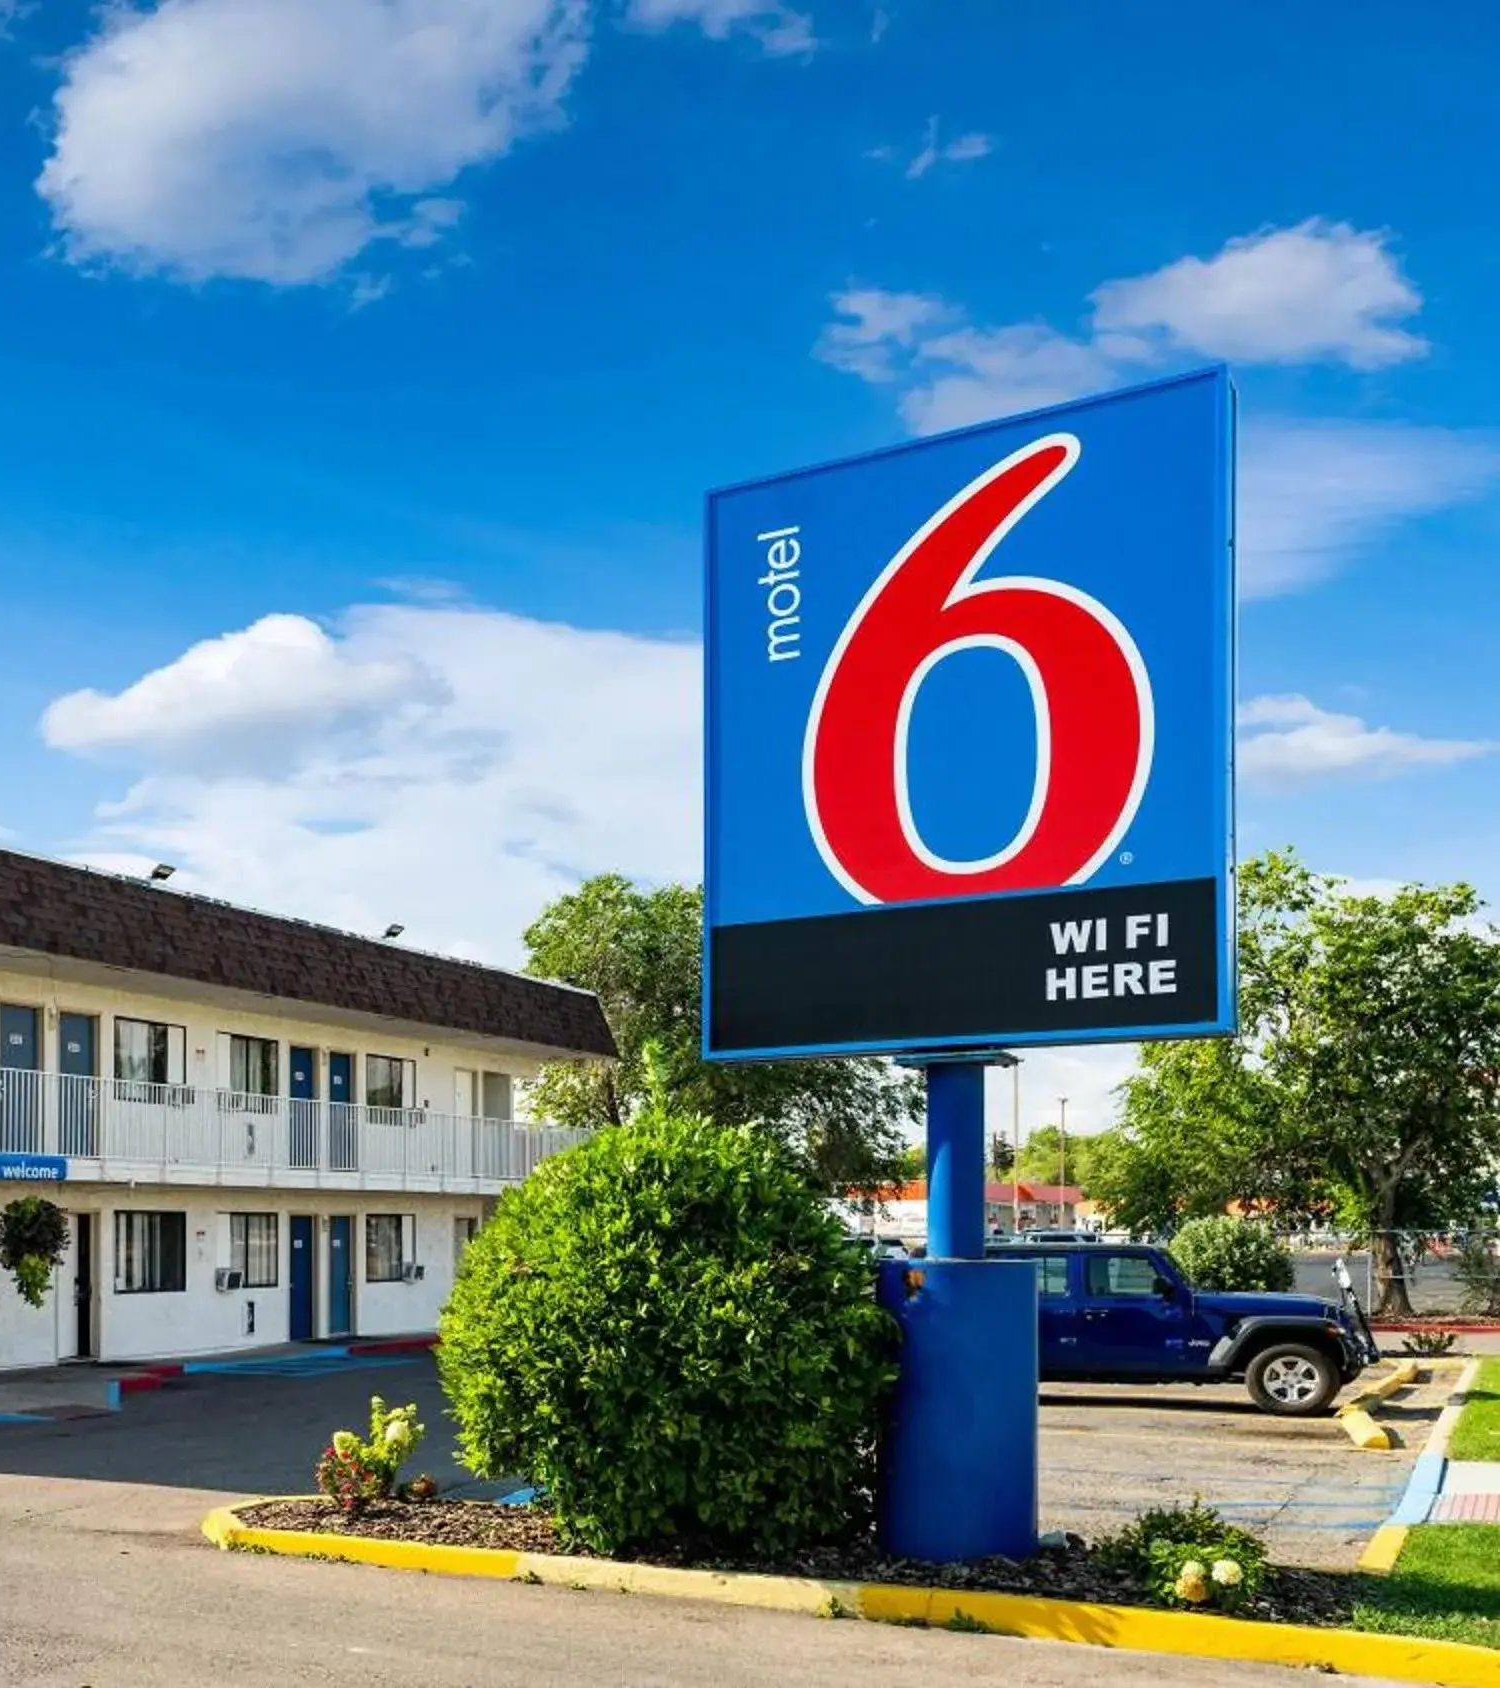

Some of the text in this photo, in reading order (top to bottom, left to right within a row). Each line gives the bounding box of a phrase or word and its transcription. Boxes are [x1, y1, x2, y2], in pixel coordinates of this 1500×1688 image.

[757, 432, 1155, 905] motel 6
[1050, 913, 1169, 956] WI FI
[1046, 959, 1178, 1001] HERE
[1, 1160, 59, 1179] welcome
